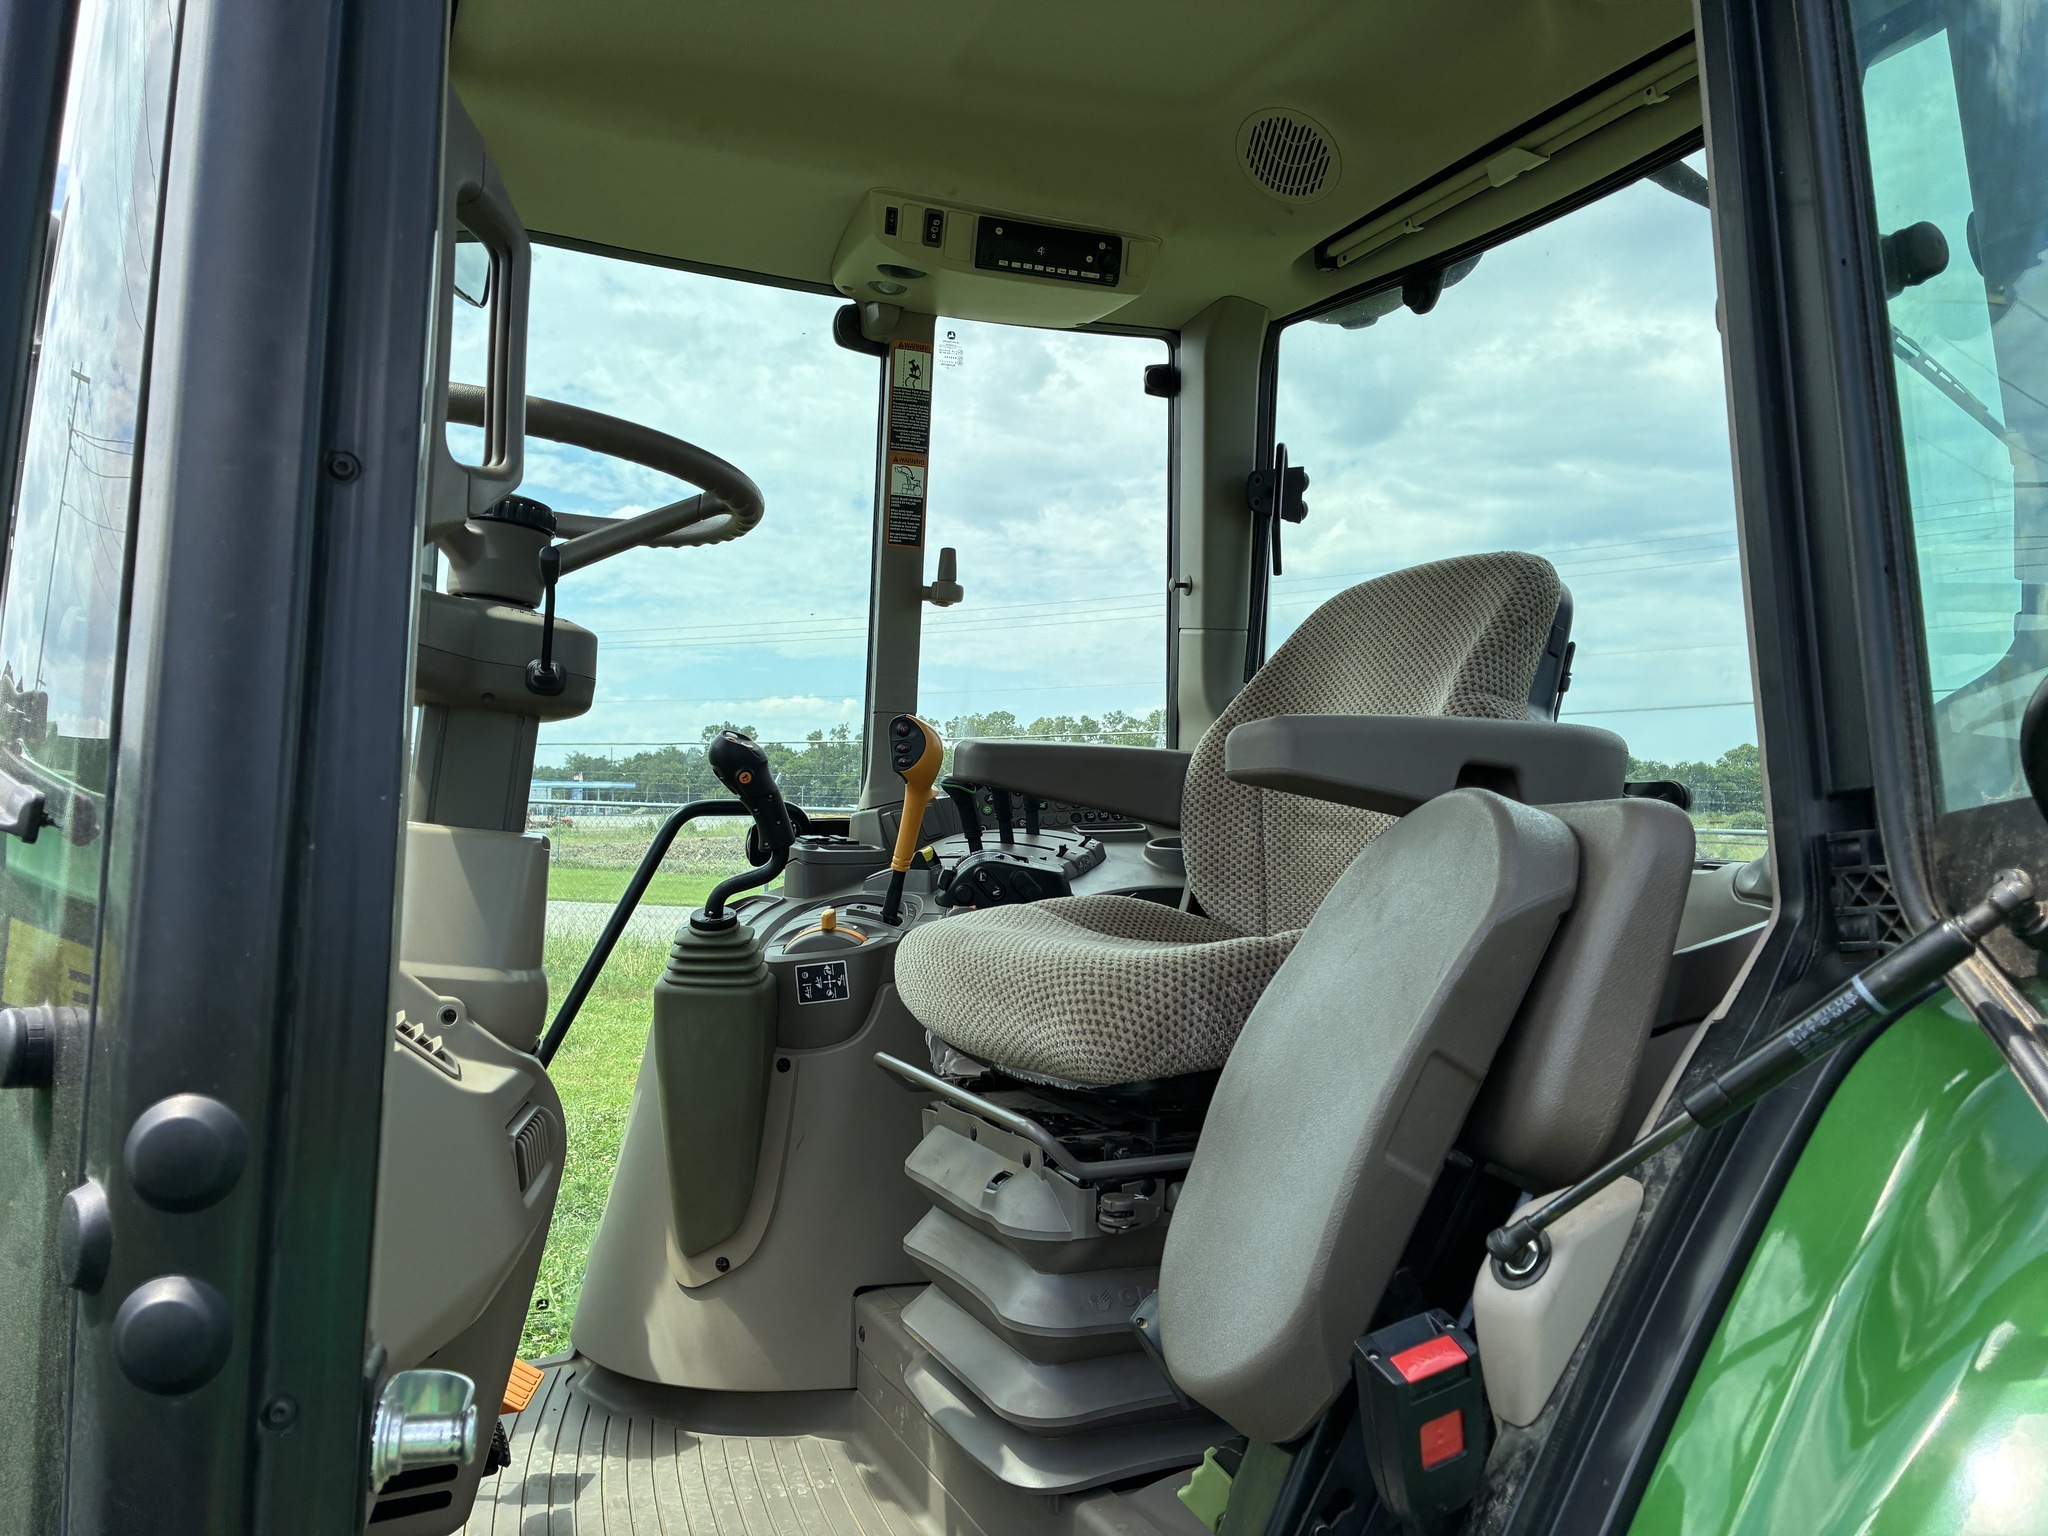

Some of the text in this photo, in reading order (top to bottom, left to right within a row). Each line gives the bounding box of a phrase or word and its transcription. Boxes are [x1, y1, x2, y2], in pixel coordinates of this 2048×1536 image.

[904, 341, 931, 352] WARNING
[899, 456, 925, 466] WARNING
[1785, 991, 1857, 1039] STABILUS
